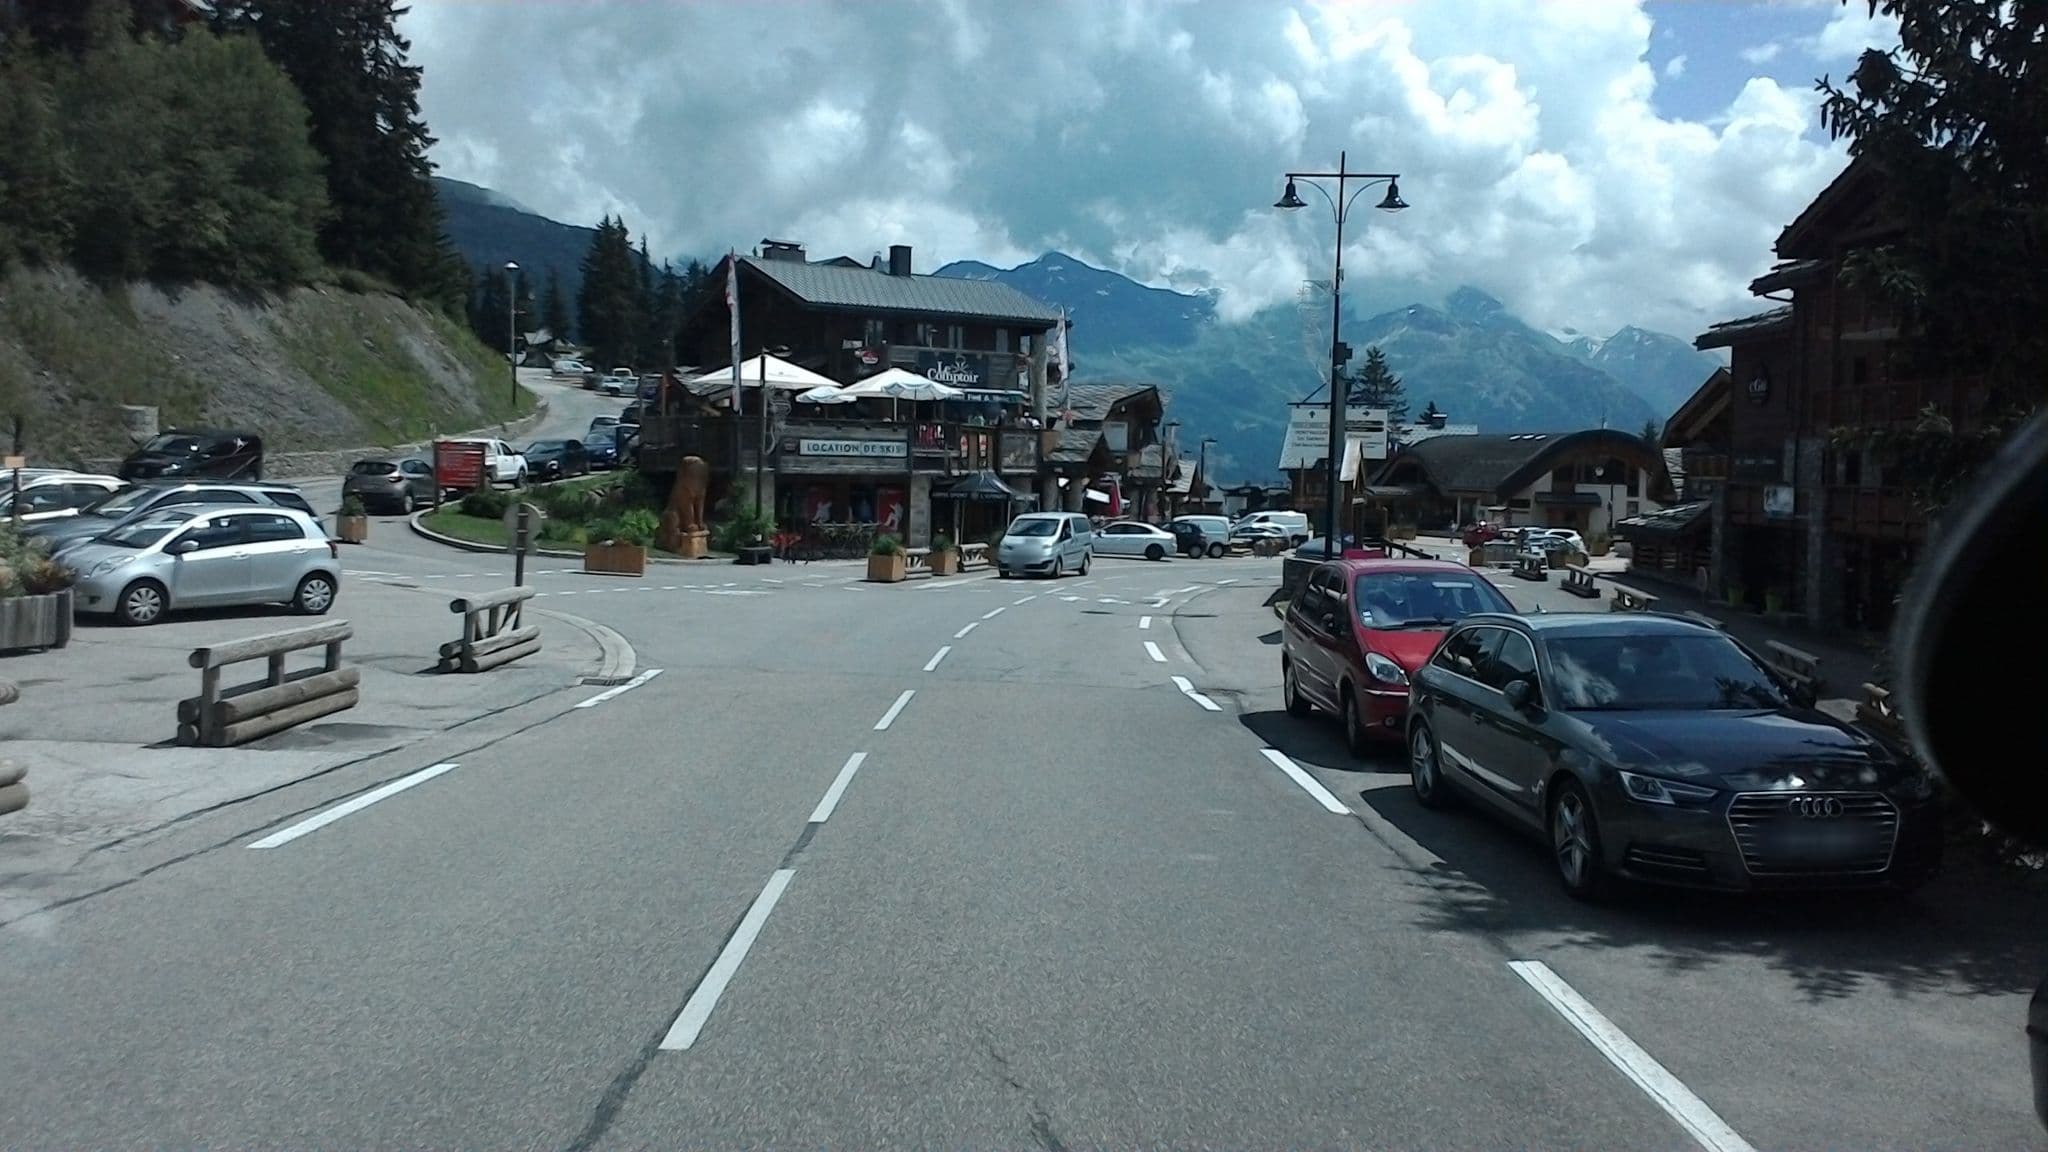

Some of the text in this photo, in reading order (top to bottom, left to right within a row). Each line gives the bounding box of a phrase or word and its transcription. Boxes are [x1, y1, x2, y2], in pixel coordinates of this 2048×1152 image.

[937, 361, 951, 372] Le
[927, 368, 979, 384] Comptoir
[807, 443, 859, 453] LOCATION
[863, 444, 876, 454] DE
[880, 444, 901, 454] SKIS
